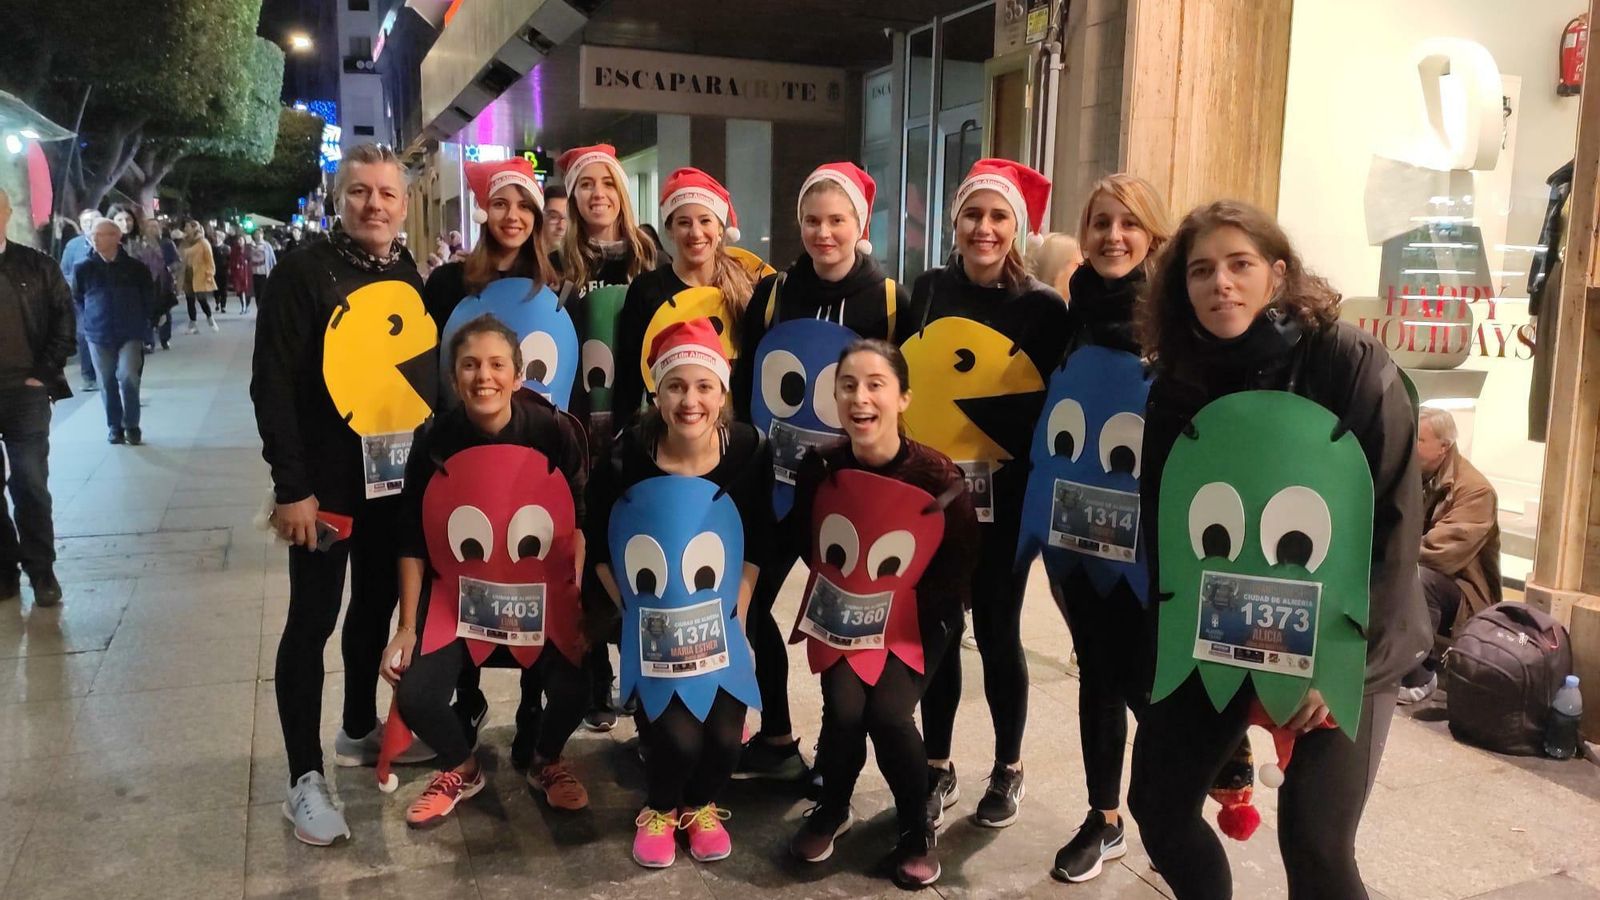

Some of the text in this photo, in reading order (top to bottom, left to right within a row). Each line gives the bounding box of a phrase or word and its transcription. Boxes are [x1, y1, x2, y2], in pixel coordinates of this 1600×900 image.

[1386, 284, 1510, 320] HAPPY
[1084, 505, 1132, 531] 1314
[491, 600, 539, 618] 1403
[841, 607, 885, 625] 1360
[1241, 602, 1310, 633] 1373
[674, 620, 720, 646] 1374
[1252, 628, 1282, 643] ALICIA
